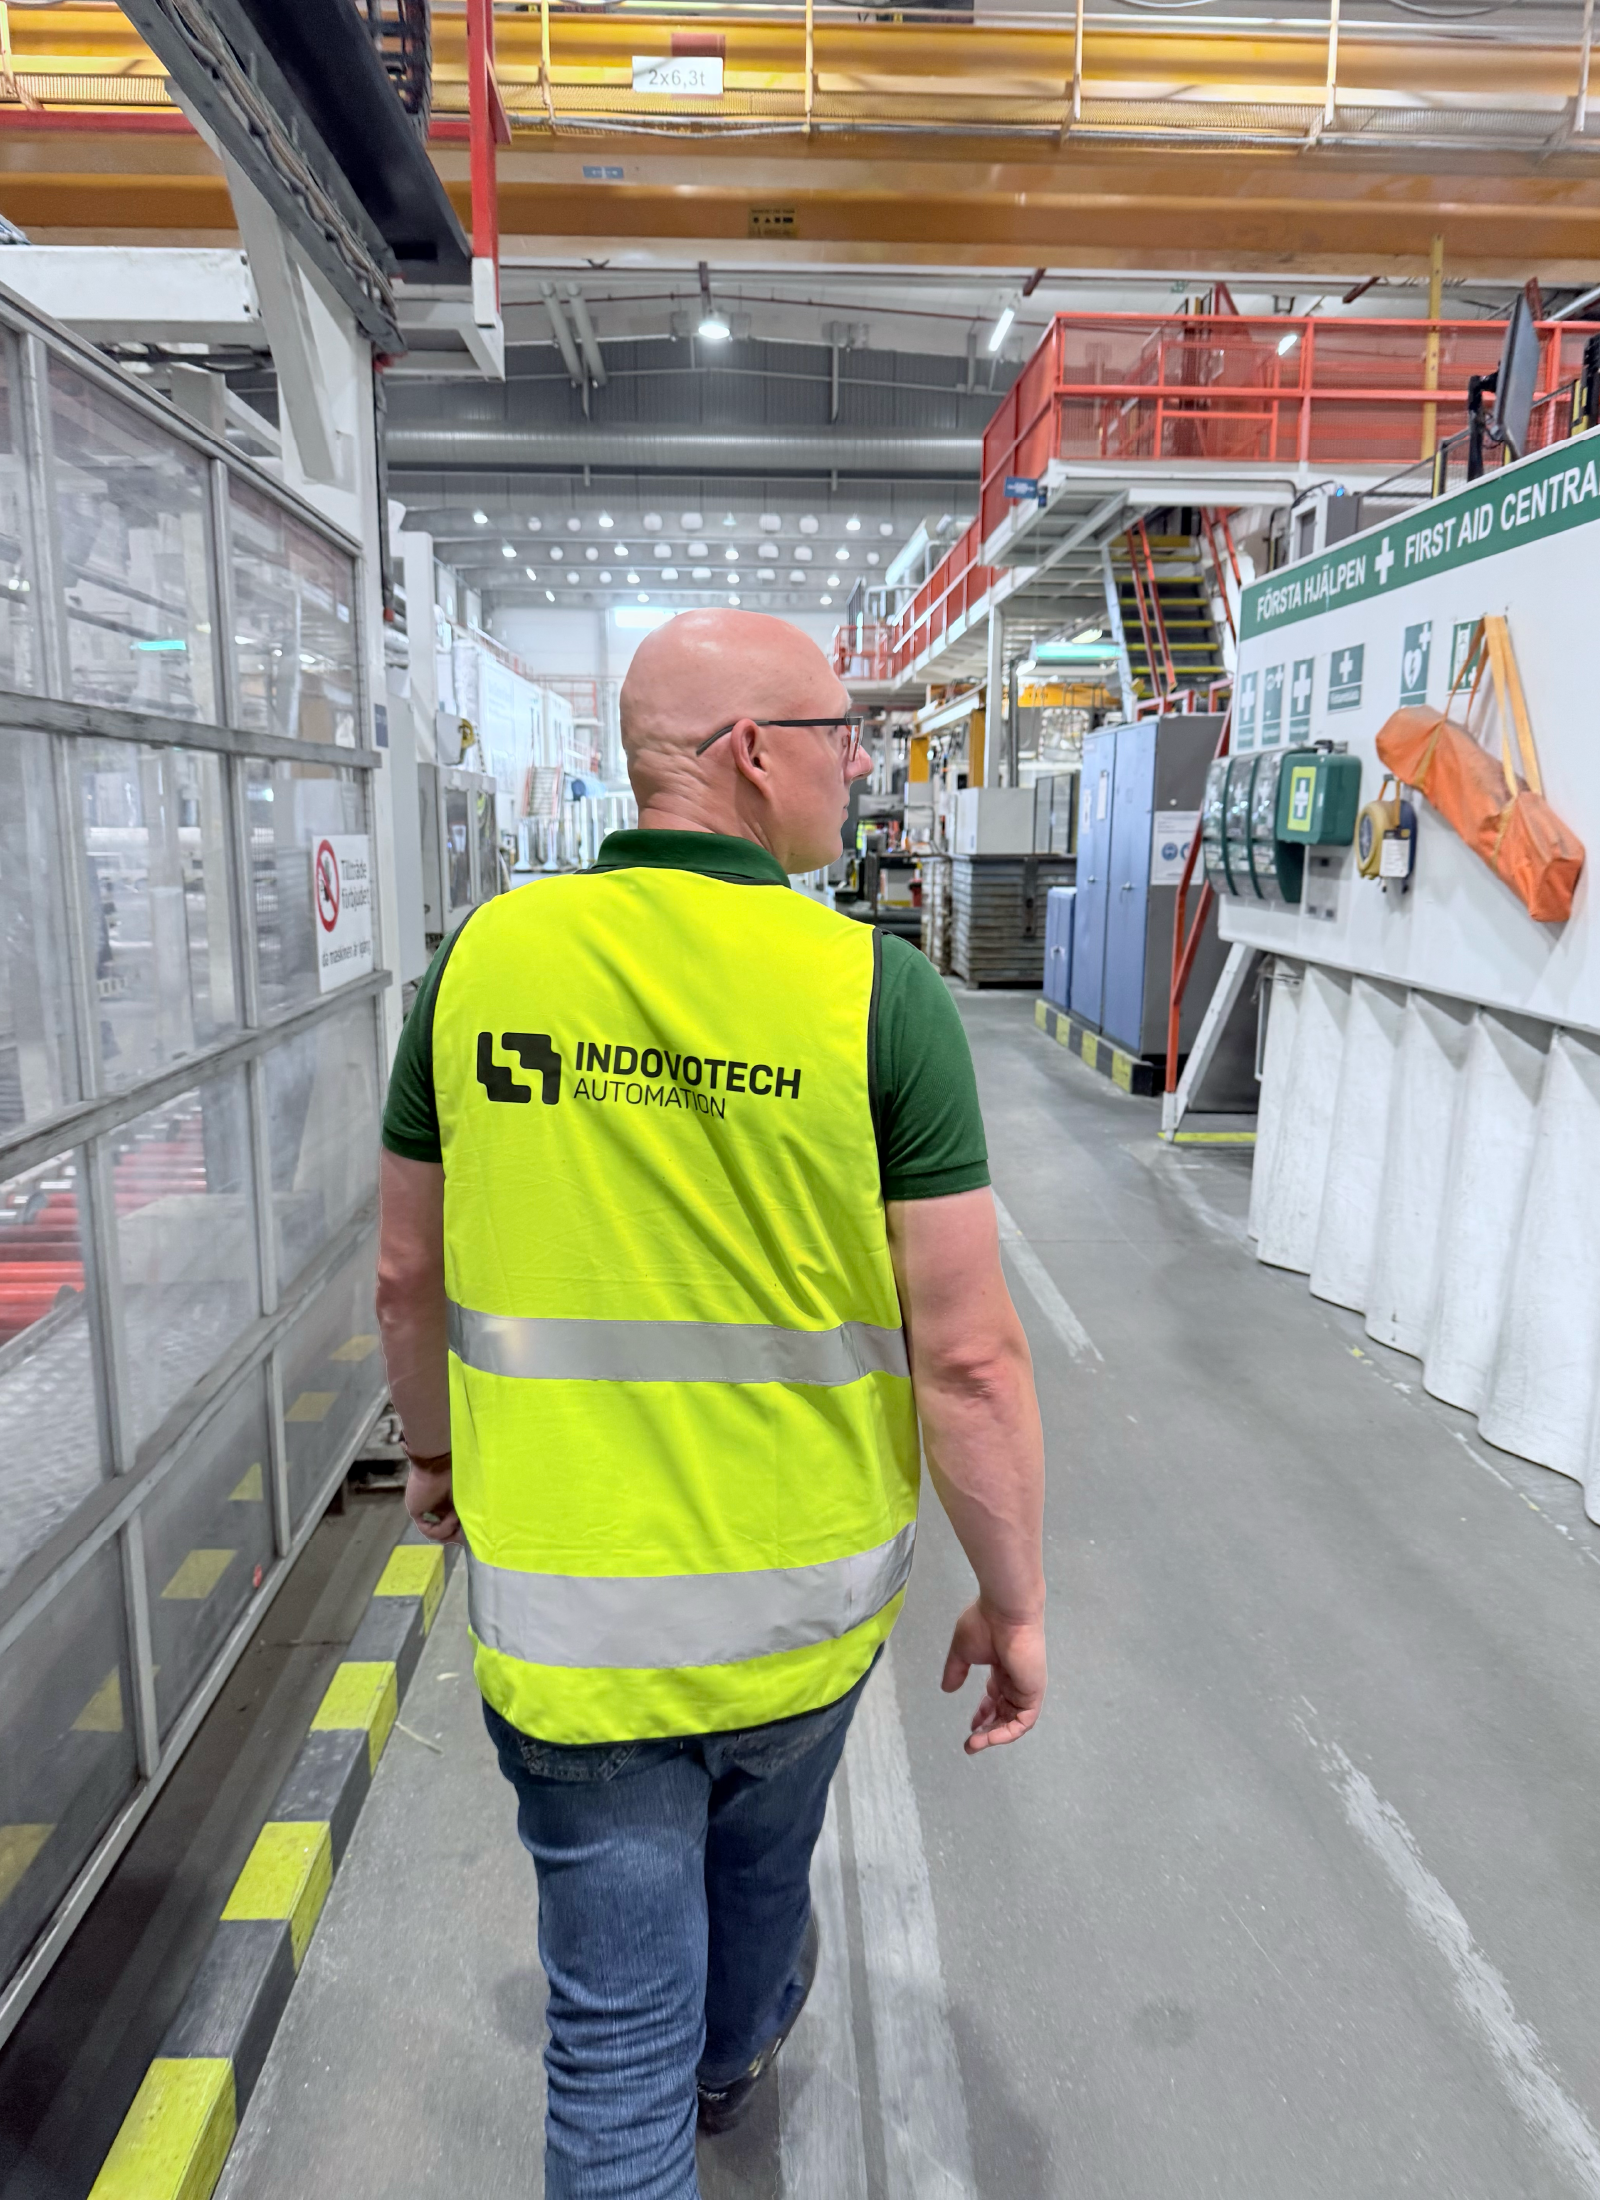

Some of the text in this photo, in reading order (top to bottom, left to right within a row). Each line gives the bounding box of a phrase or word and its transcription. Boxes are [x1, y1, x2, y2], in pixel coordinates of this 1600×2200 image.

[648, 68, 706, 89] 2x6,3t
[1256, 459, 1600, 622] FÖRSTA HJÄLPEN FIRST AID CENTRA
[576, 1041, 802, 1099] INDOVOTECH
[573, 1078, 726, 1119] AUTOMATION
